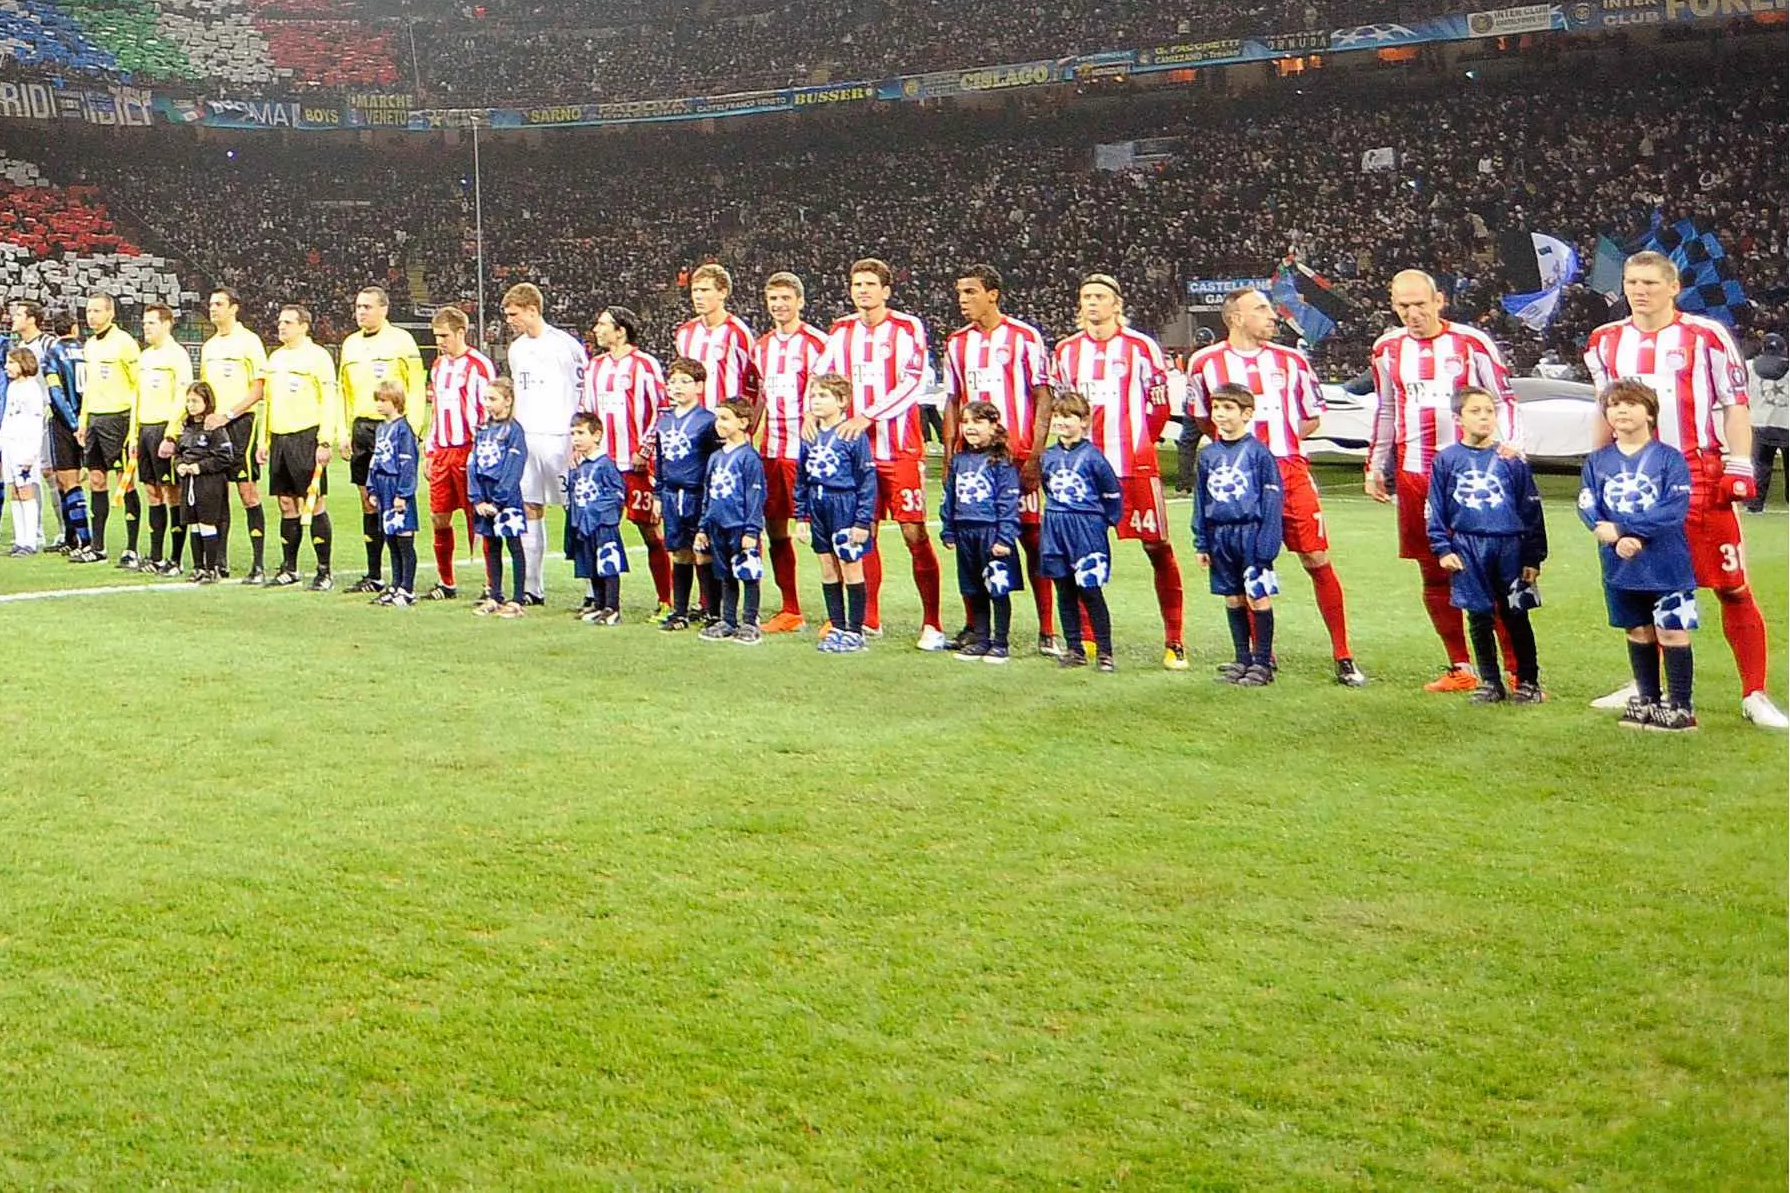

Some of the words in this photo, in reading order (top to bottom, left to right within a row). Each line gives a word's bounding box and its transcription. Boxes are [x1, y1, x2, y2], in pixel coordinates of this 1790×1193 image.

[1602, 11, 1659, 26] CLUB
[960, 63, 1049, 91] CISLAGO
[356, 94, 413, 109] MARCHE
[304, 108, 339, 124] BOYS
[364, 110, 407, 125] VENETO
[530, 106, 581, 123] SARNO
[1189, 280, 1273, 293] CASTELLAN
[631, 489, 654, 511] 23
[900, 488, 923, 512] 33
[1129, 508, 1157, 534] 44
